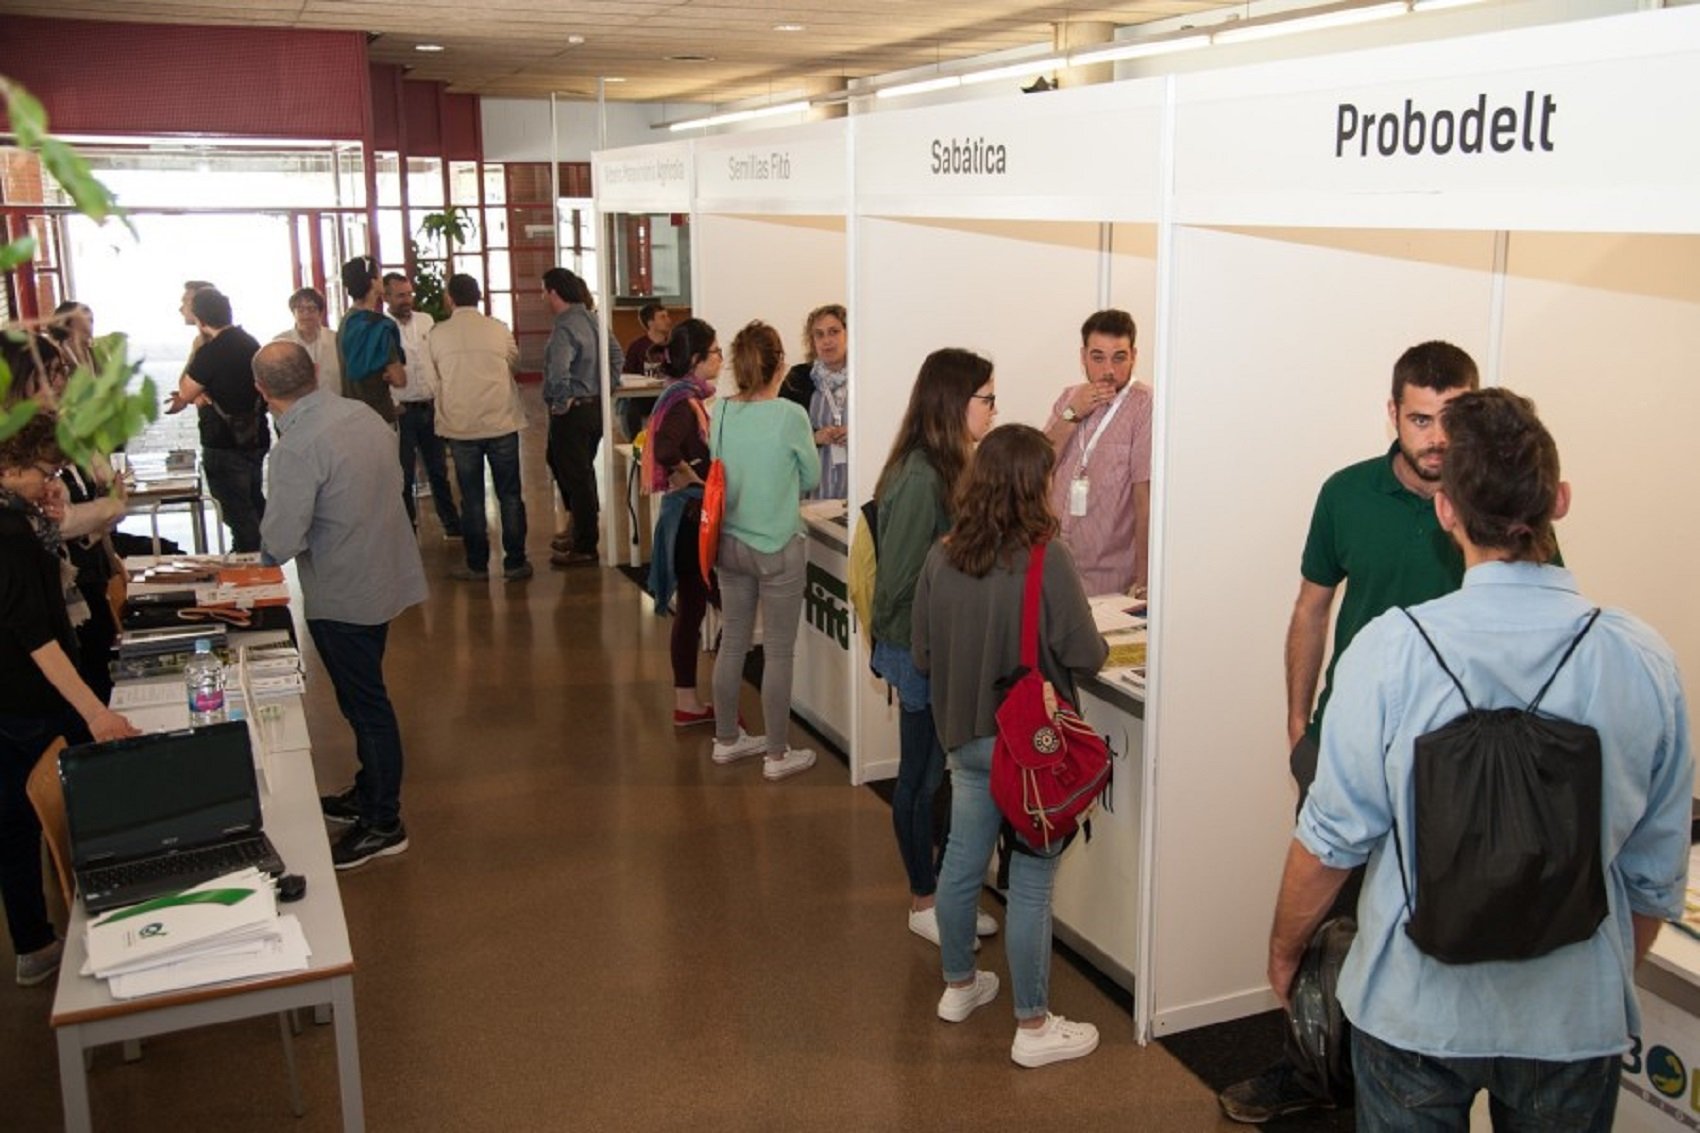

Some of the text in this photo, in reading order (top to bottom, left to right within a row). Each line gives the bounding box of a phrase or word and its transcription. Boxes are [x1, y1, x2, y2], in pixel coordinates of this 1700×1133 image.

[1335, 90, 1557, 158] Probodelt
[728, 152, 791, 181] Semillas Fitó
[931, 137, 1007, 175] Sabática
